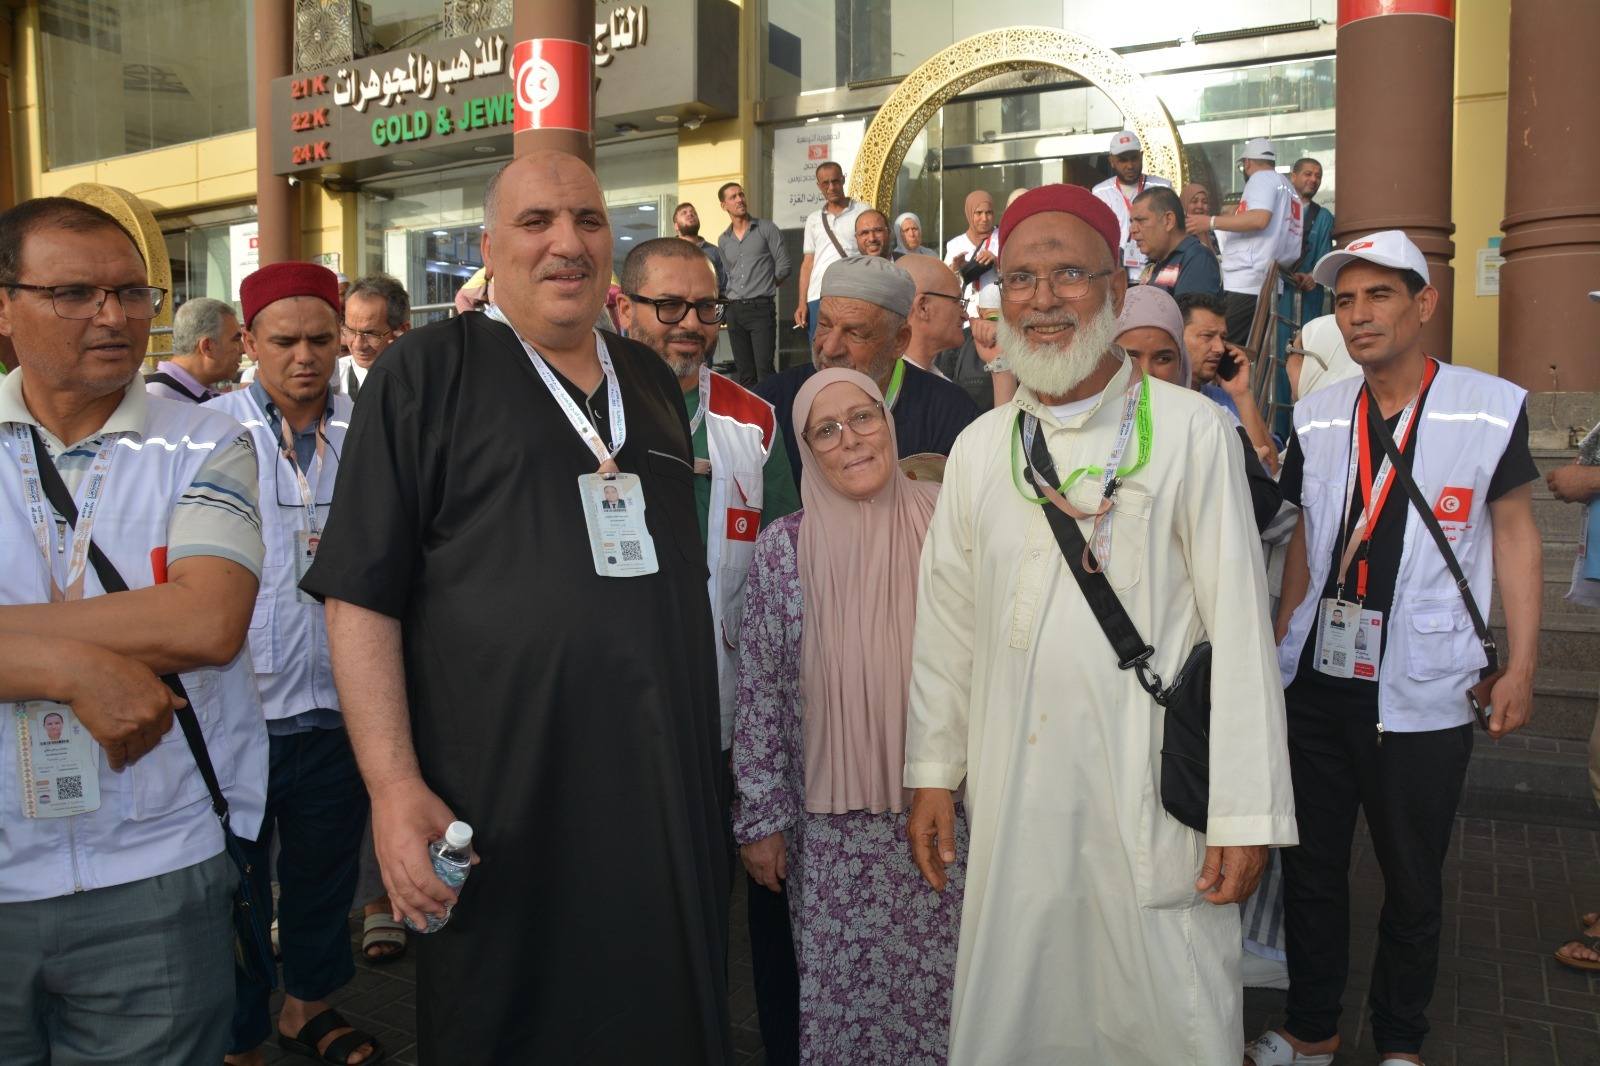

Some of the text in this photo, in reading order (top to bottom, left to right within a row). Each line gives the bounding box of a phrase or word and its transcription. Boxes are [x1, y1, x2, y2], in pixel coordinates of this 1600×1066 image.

[333, 52, 433, 112] والمجوهرات
[437, 34, 503, 93] للذهب
[371, 110, 428, 146] GOLD
[435, 105, 451, 135] &
